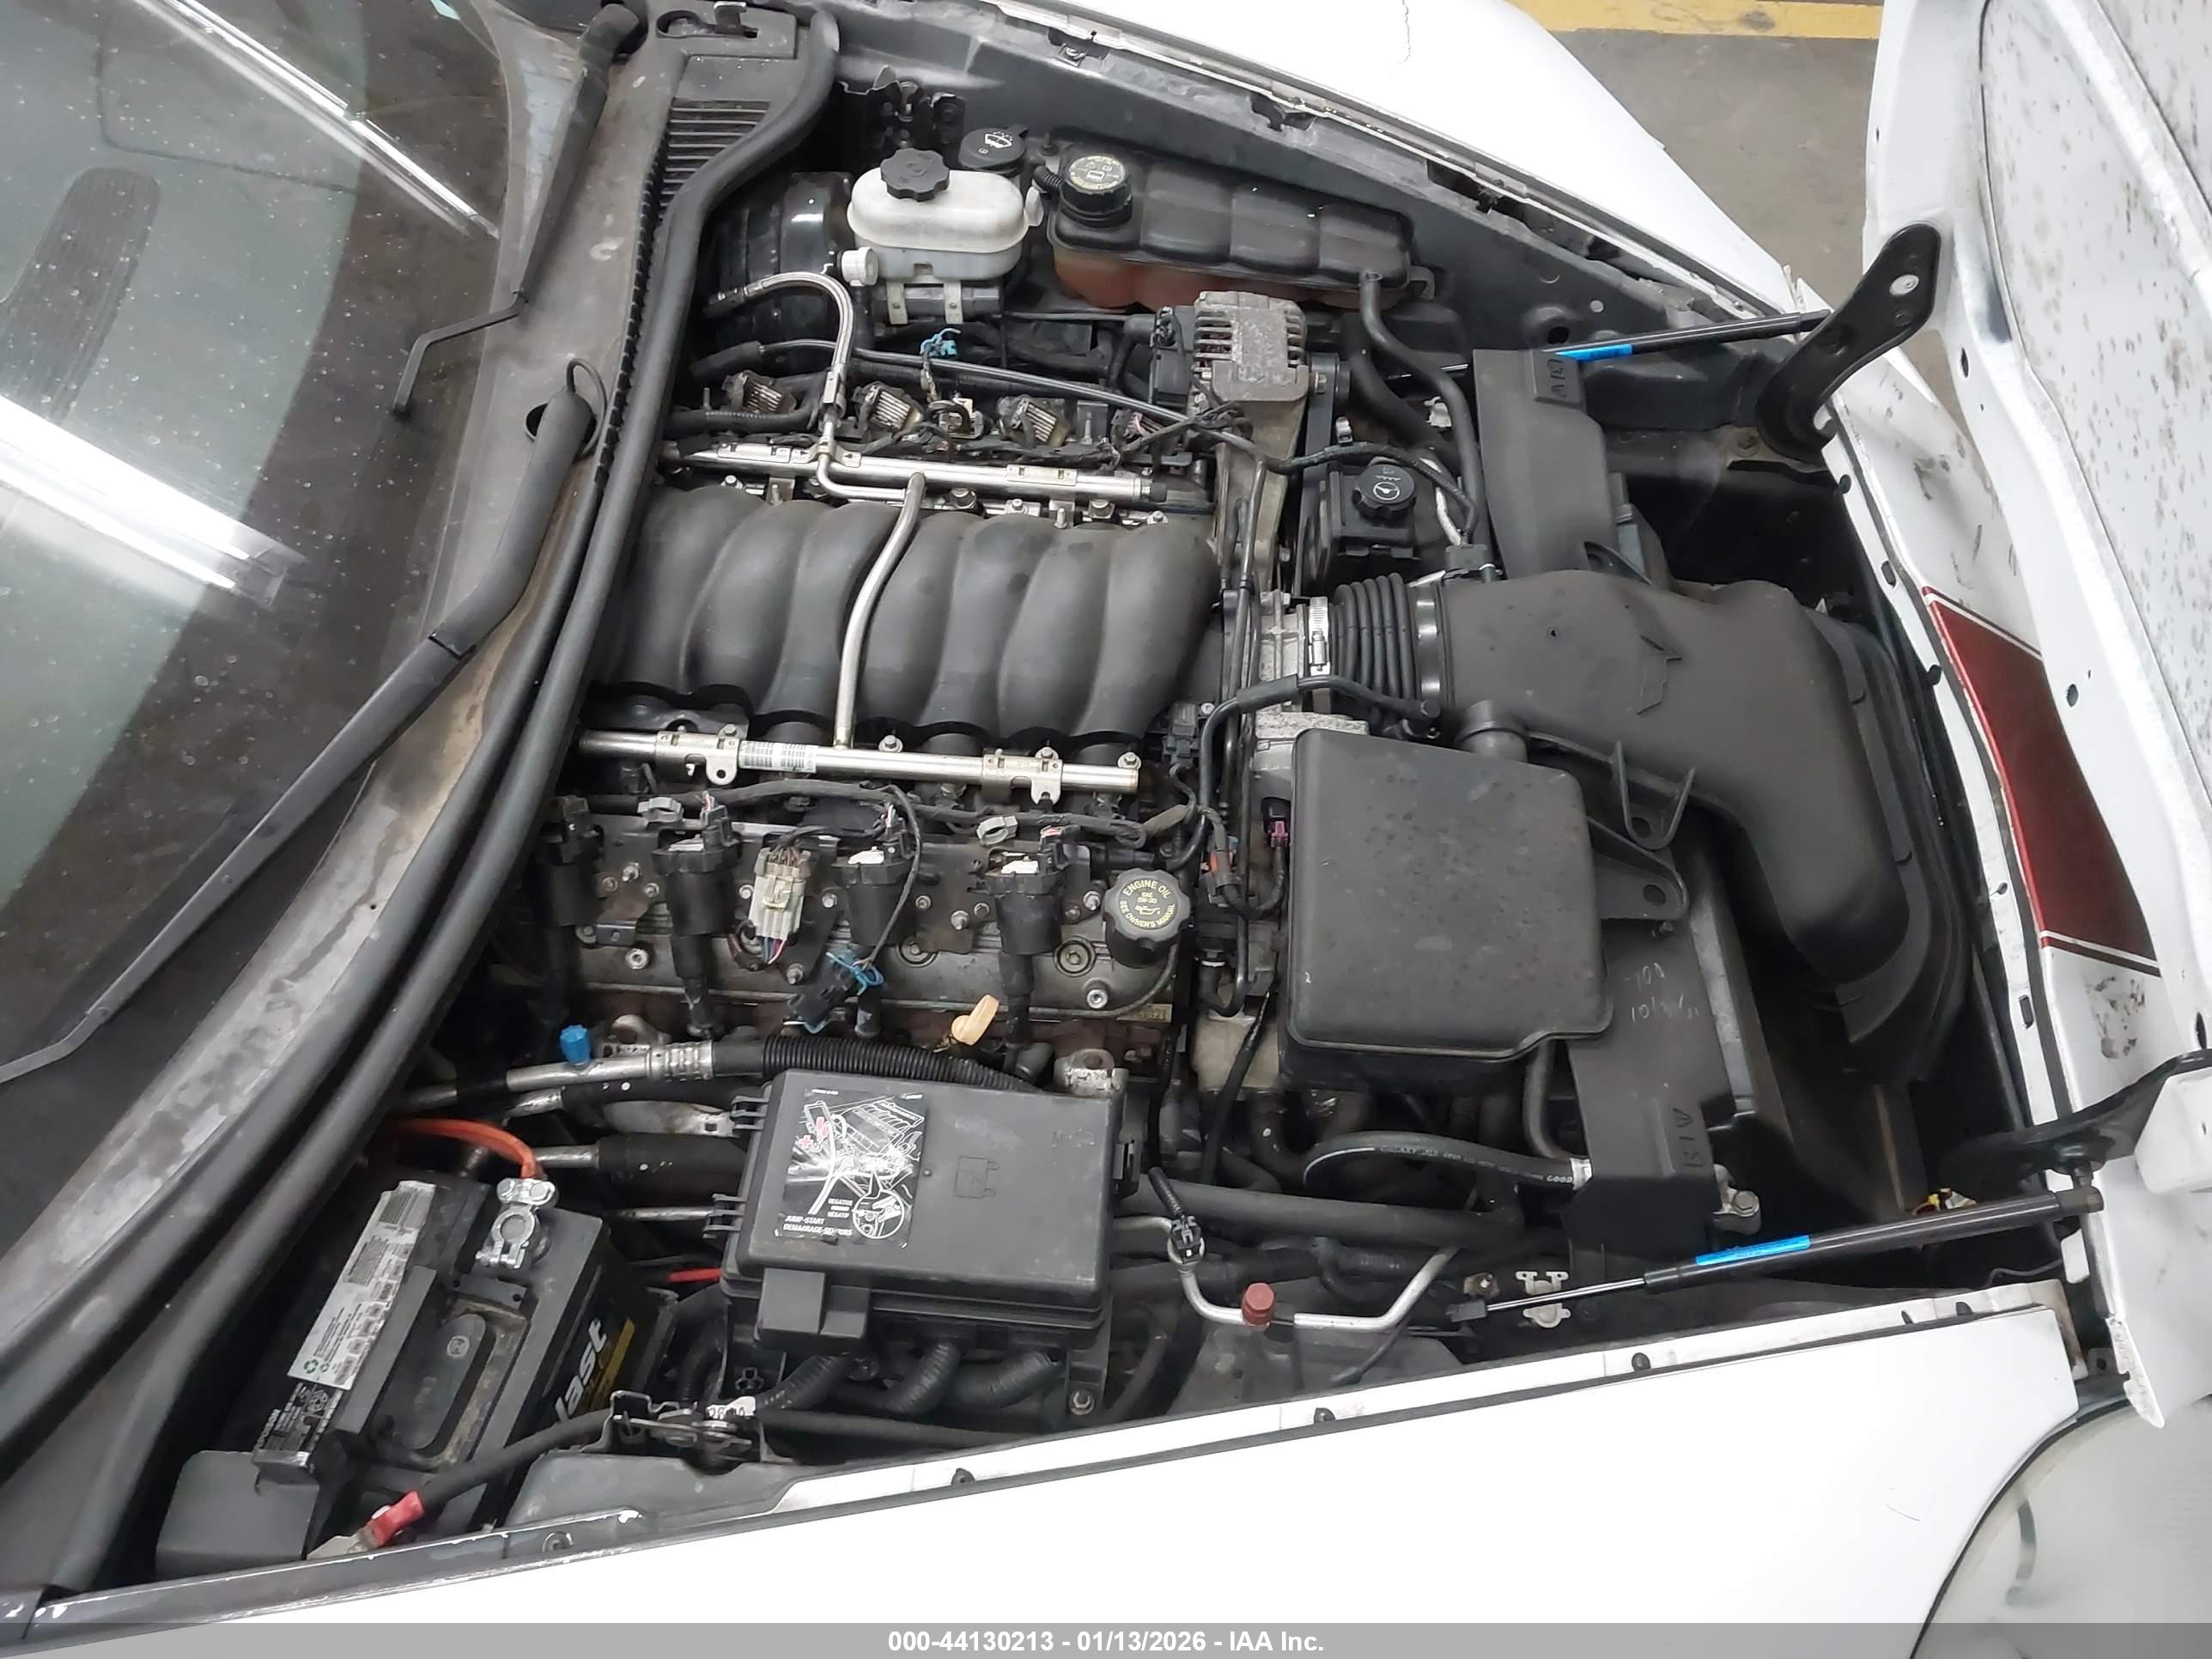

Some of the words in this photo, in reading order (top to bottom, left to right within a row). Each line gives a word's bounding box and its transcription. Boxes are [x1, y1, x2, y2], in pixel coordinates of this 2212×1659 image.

[1122, 879, 1158, 896] ENGINE
[1158, 885, 1171, 899] OIL
[1119, 900, 1130, 914] SEE
[1155, 903, 1176, 926] MANUAL
[555, 1318, 607, 1423] last
